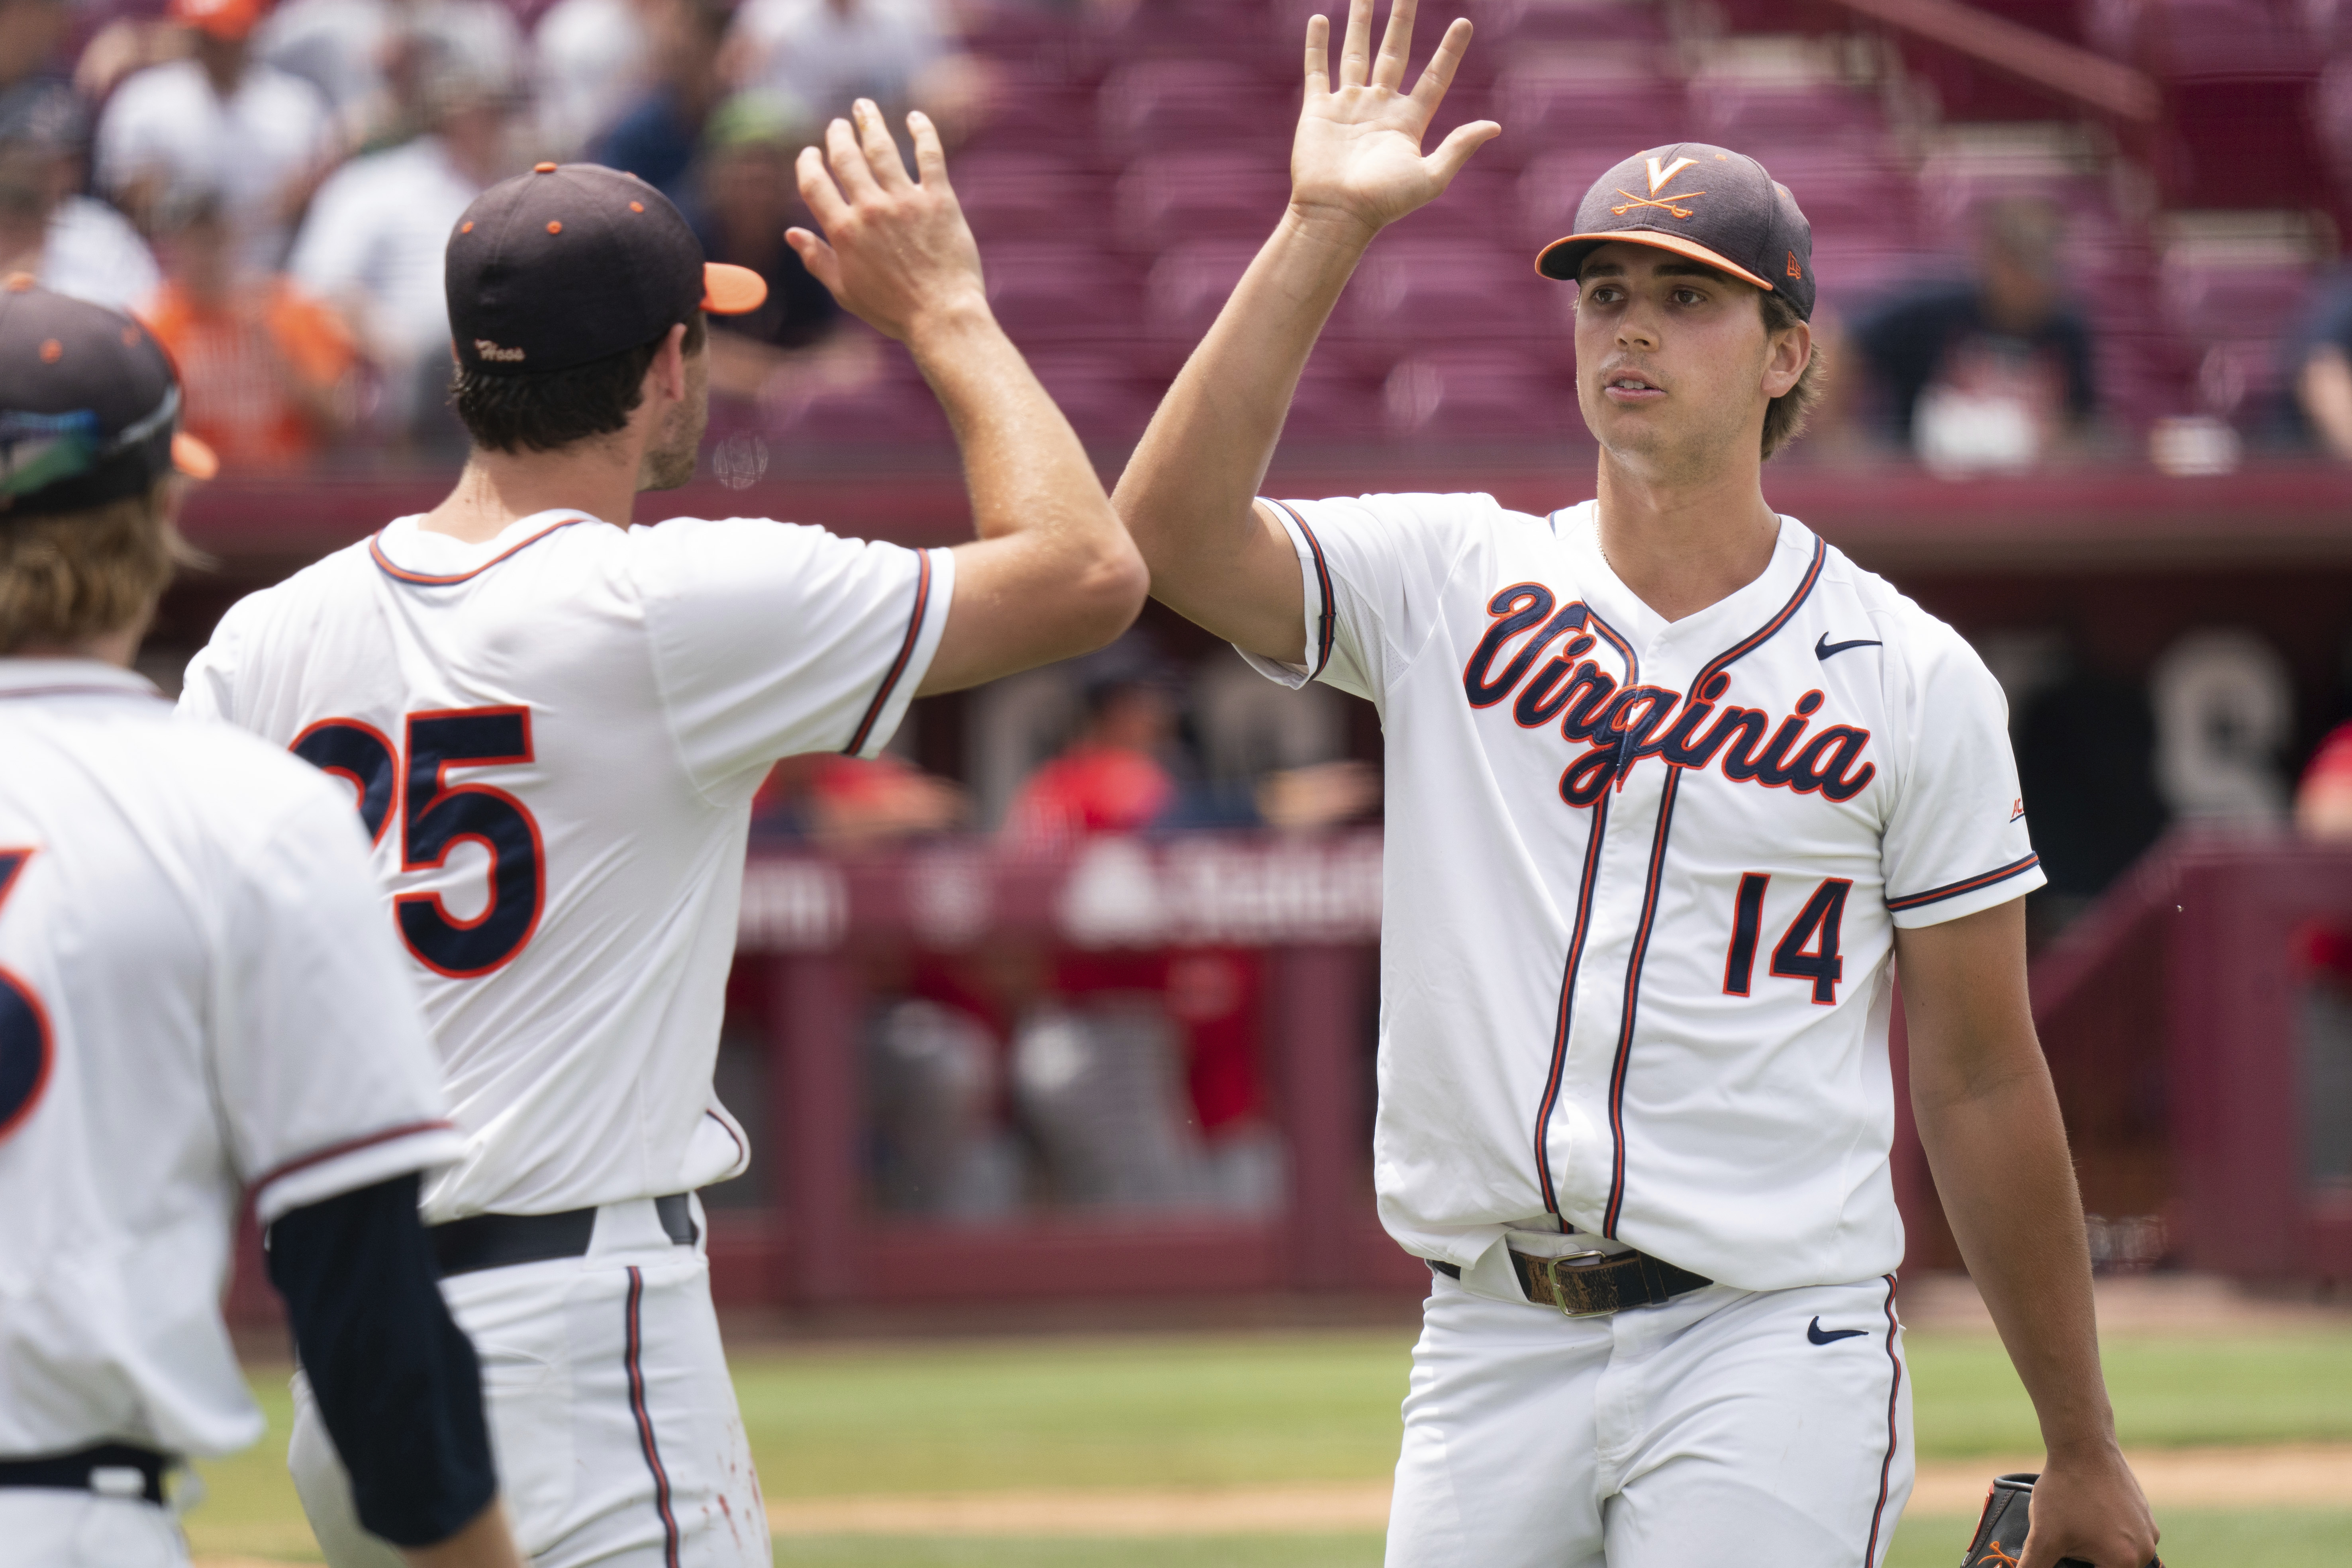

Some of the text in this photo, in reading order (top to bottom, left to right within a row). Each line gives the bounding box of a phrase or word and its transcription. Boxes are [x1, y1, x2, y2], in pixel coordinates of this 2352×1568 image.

[1645, 157, 1700, 197] V
[1463, 581, 1876, 808] Virginia
[2011, 798, 2024, 818] AC
[1722, 871, 1854, 1005] 14
